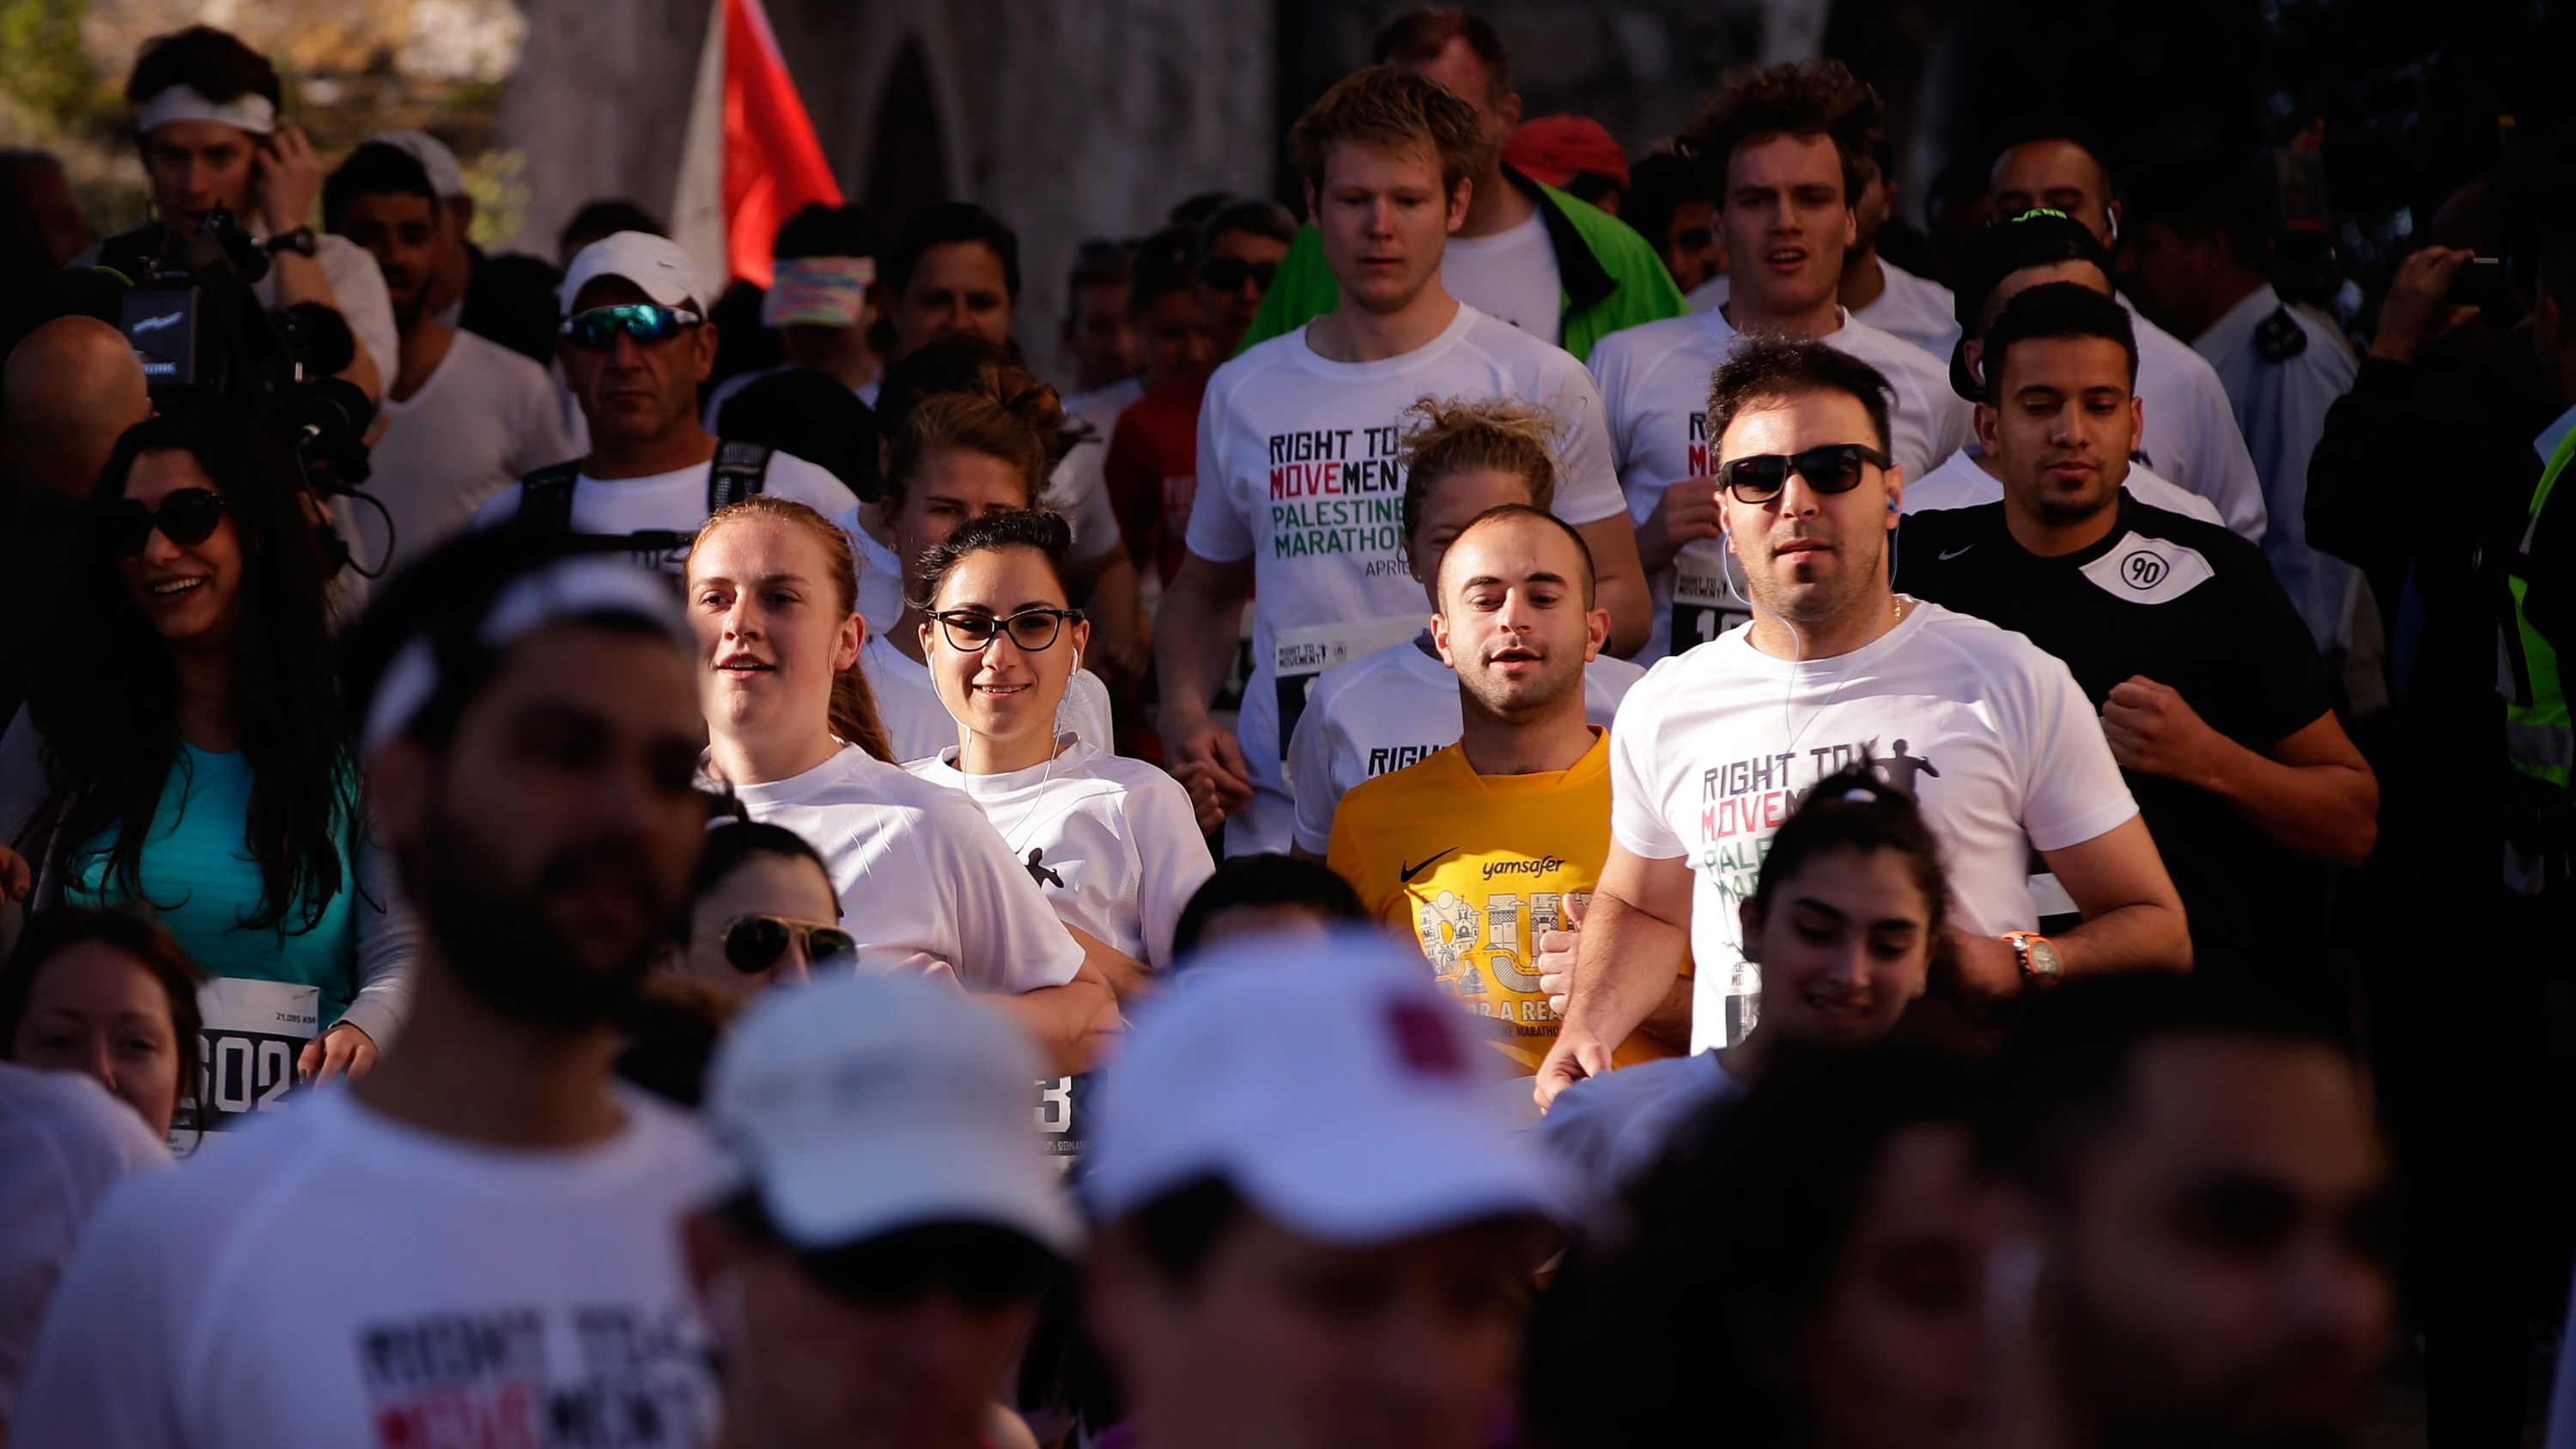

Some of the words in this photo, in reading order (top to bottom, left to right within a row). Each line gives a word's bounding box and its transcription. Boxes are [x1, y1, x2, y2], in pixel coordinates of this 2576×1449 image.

[1270, 431, 1353, 465] RIGHT
[1364, 427, 1398, 458] TO
[1270, 459, 1399, 501] MOVEMEN
[2132, 557, 2160, 584] 90
[1368, 744, 1448, 776] RIG
[1703, 752, 1796, 803] RIGHT
[1482, 855, 1564, 881] yamsafer
[1500, 1000, 1515, 1022] A
[1516, 1025, 1559, 1038] MARATHO
